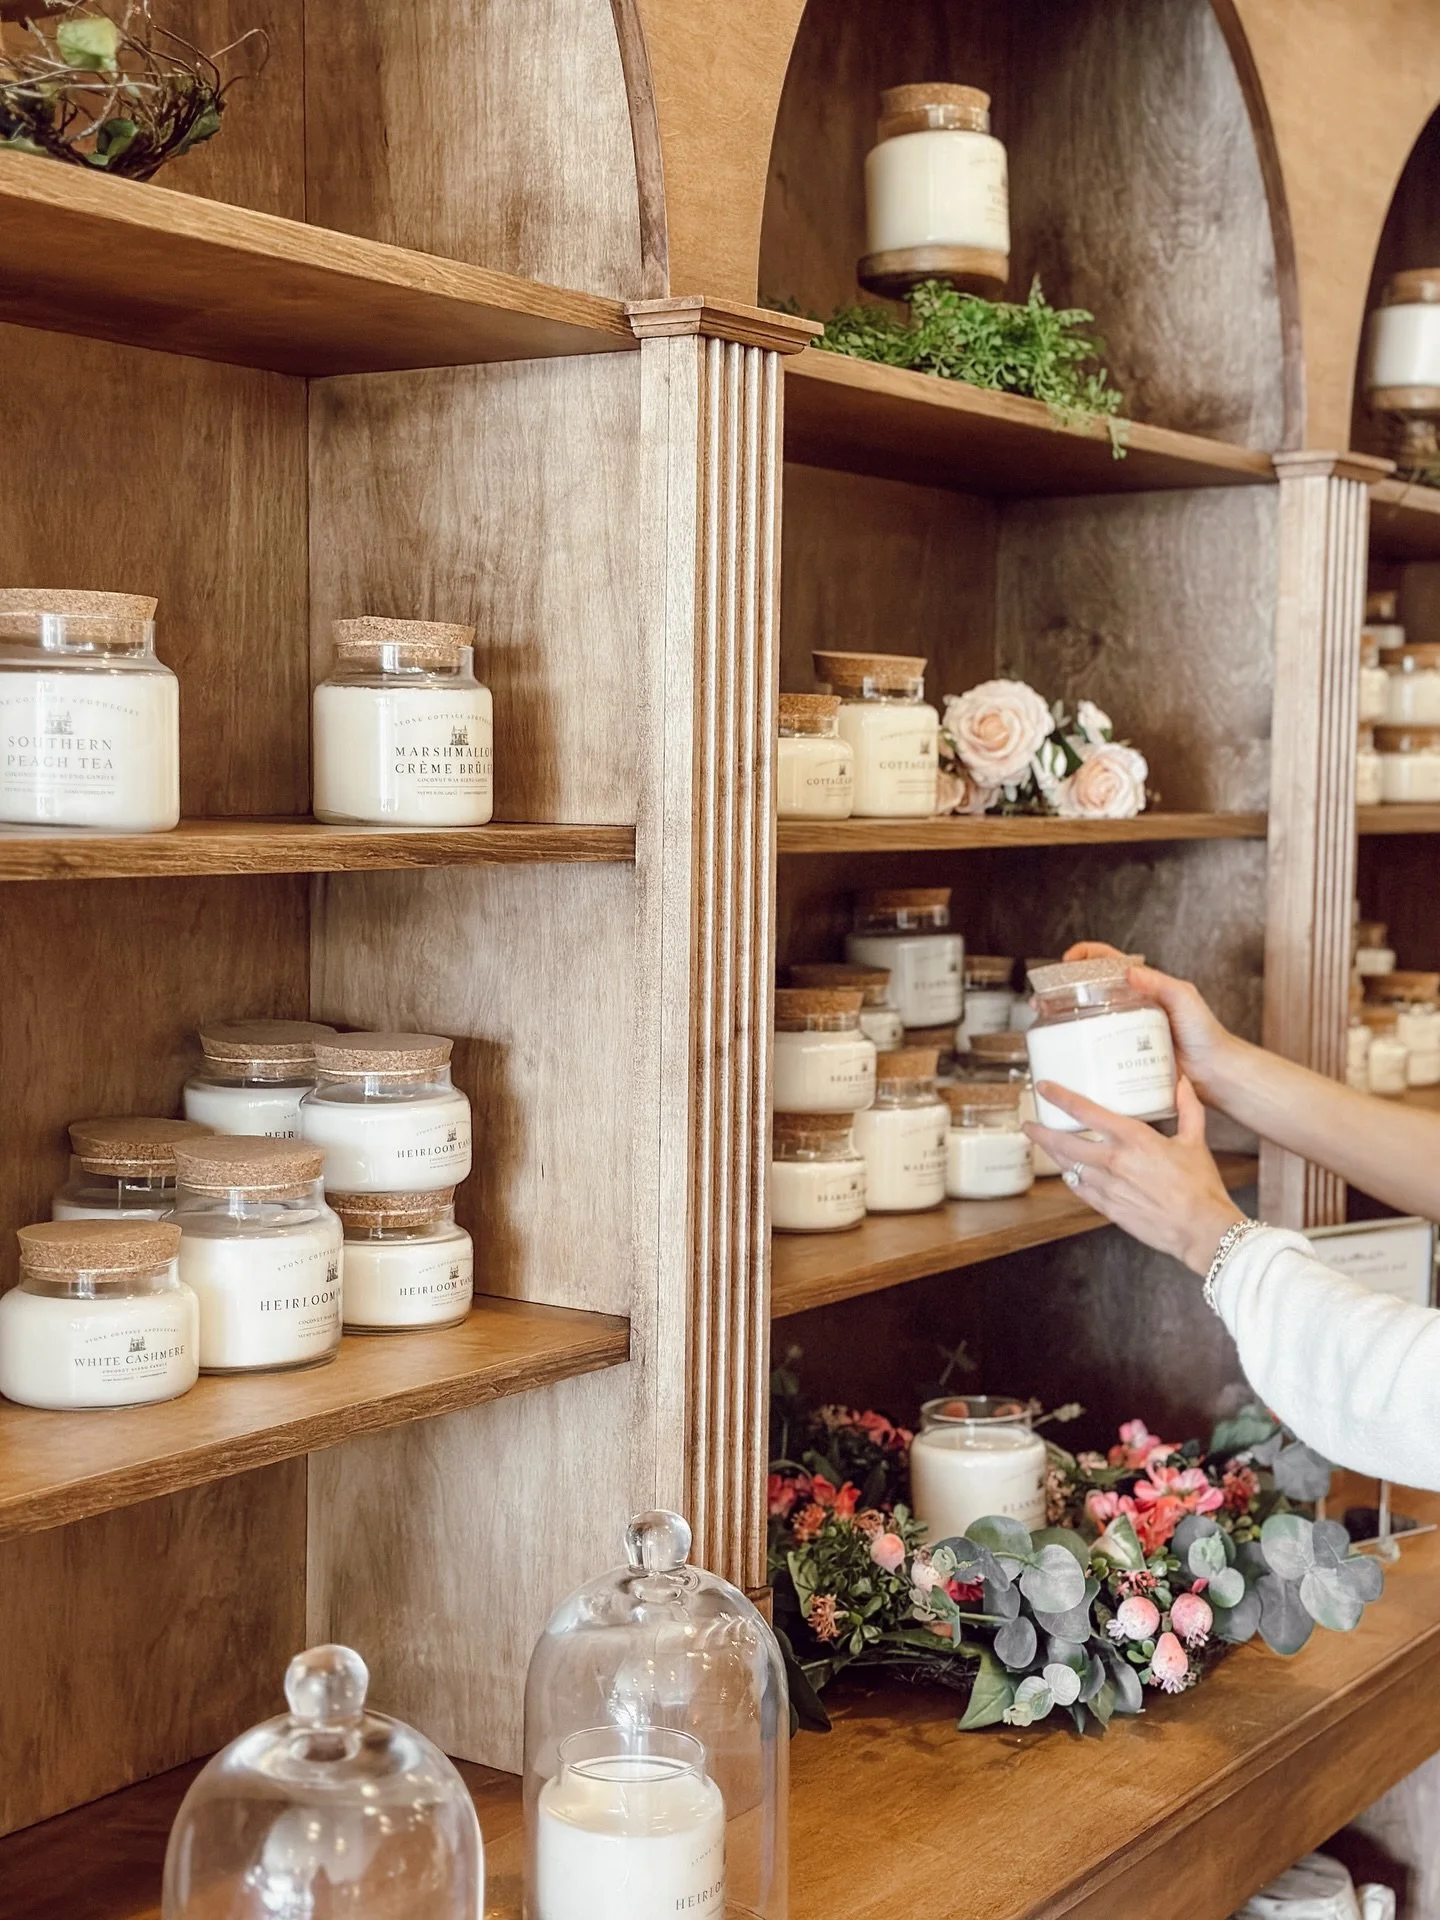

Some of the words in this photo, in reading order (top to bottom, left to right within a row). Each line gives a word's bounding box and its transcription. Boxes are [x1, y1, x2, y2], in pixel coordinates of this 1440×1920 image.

[8, 735, 113, 751] SOUTHERN
[7, 754, 68, 769] PEACH
[79, 757, 114, 770] TEA
[395, 761, 452, 775] CRÈME
[265, 1130, 295, 1140] HEIR
[397, 1144, 455, 1159] HEIRLOOM
[399, 1281, 457, 1297] HEIRLOOM
[260, 1291, 336, 1312] HEIRLOOM
[75, 1356, 120, 1368] WHITE
[126, 1345, 185, 1365] CASHMERE
[676, 1880, 724, 1911] HEIRLO
